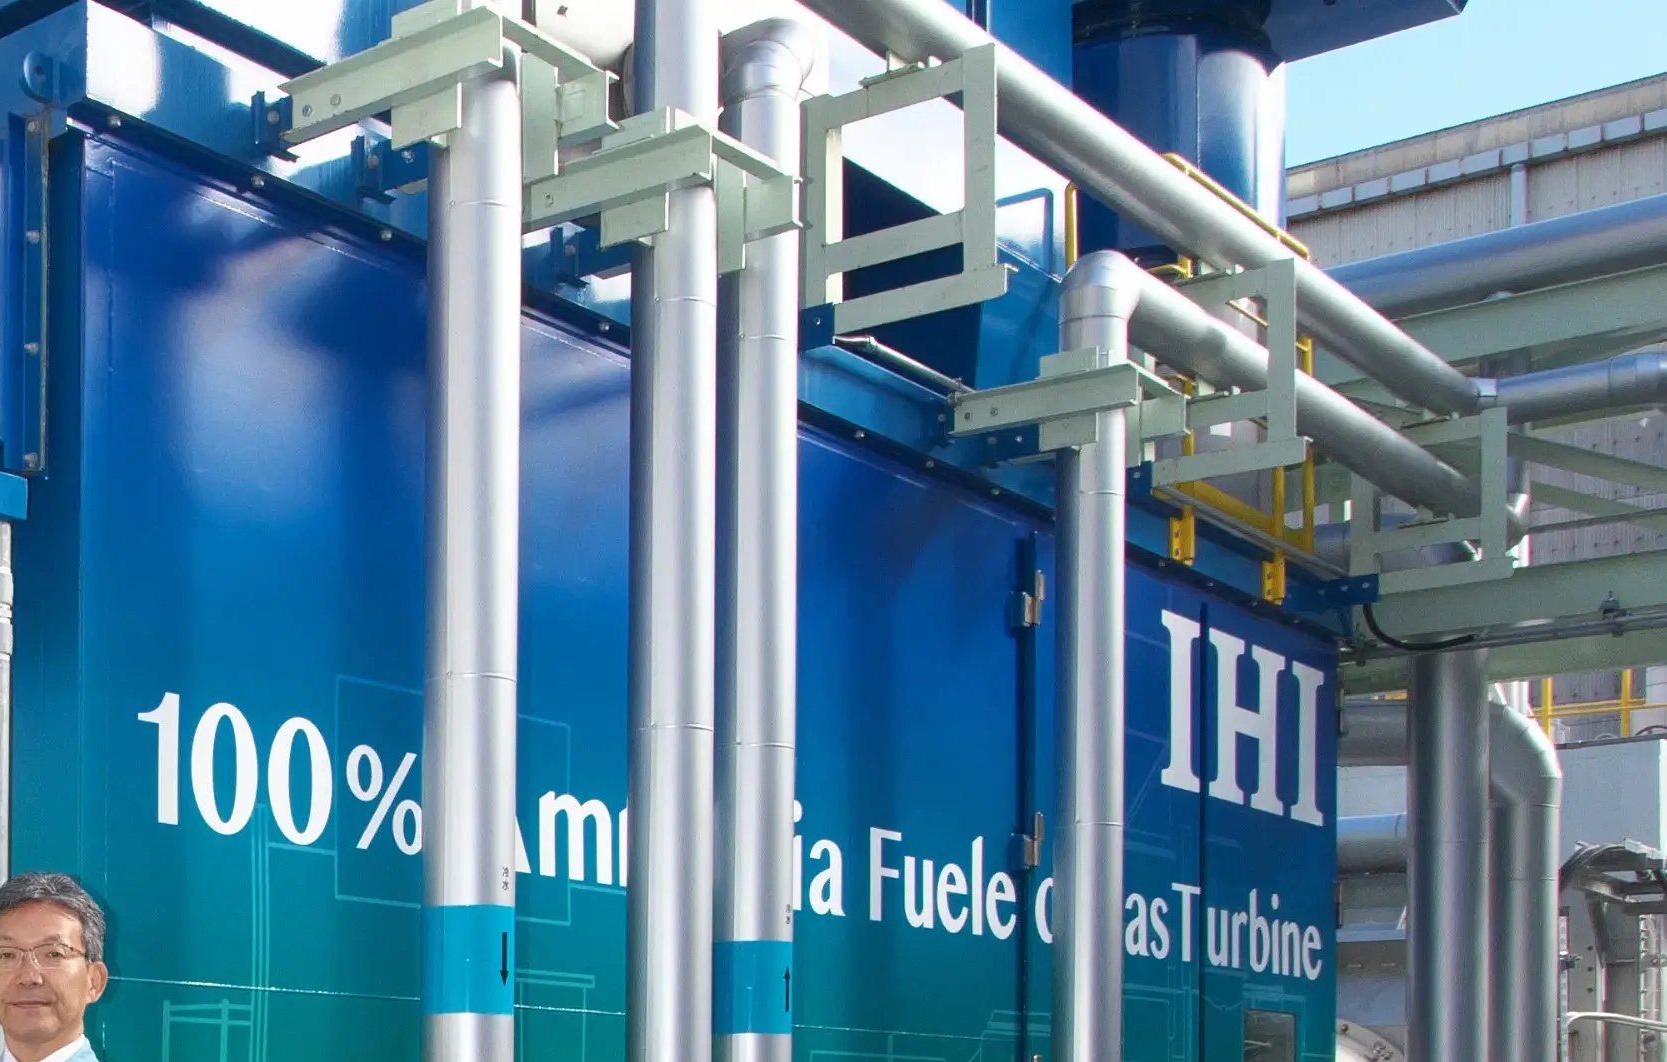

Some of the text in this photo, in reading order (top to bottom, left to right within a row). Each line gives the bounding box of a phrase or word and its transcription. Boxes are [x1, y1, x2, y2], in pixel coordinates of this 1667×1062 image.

[137, 691, 423, 856] 100%
[1125, 892, 1171, 960] as
[1172, 882, 1322, 981] Turbine
[1161, 609, 1325, 826] IHI
